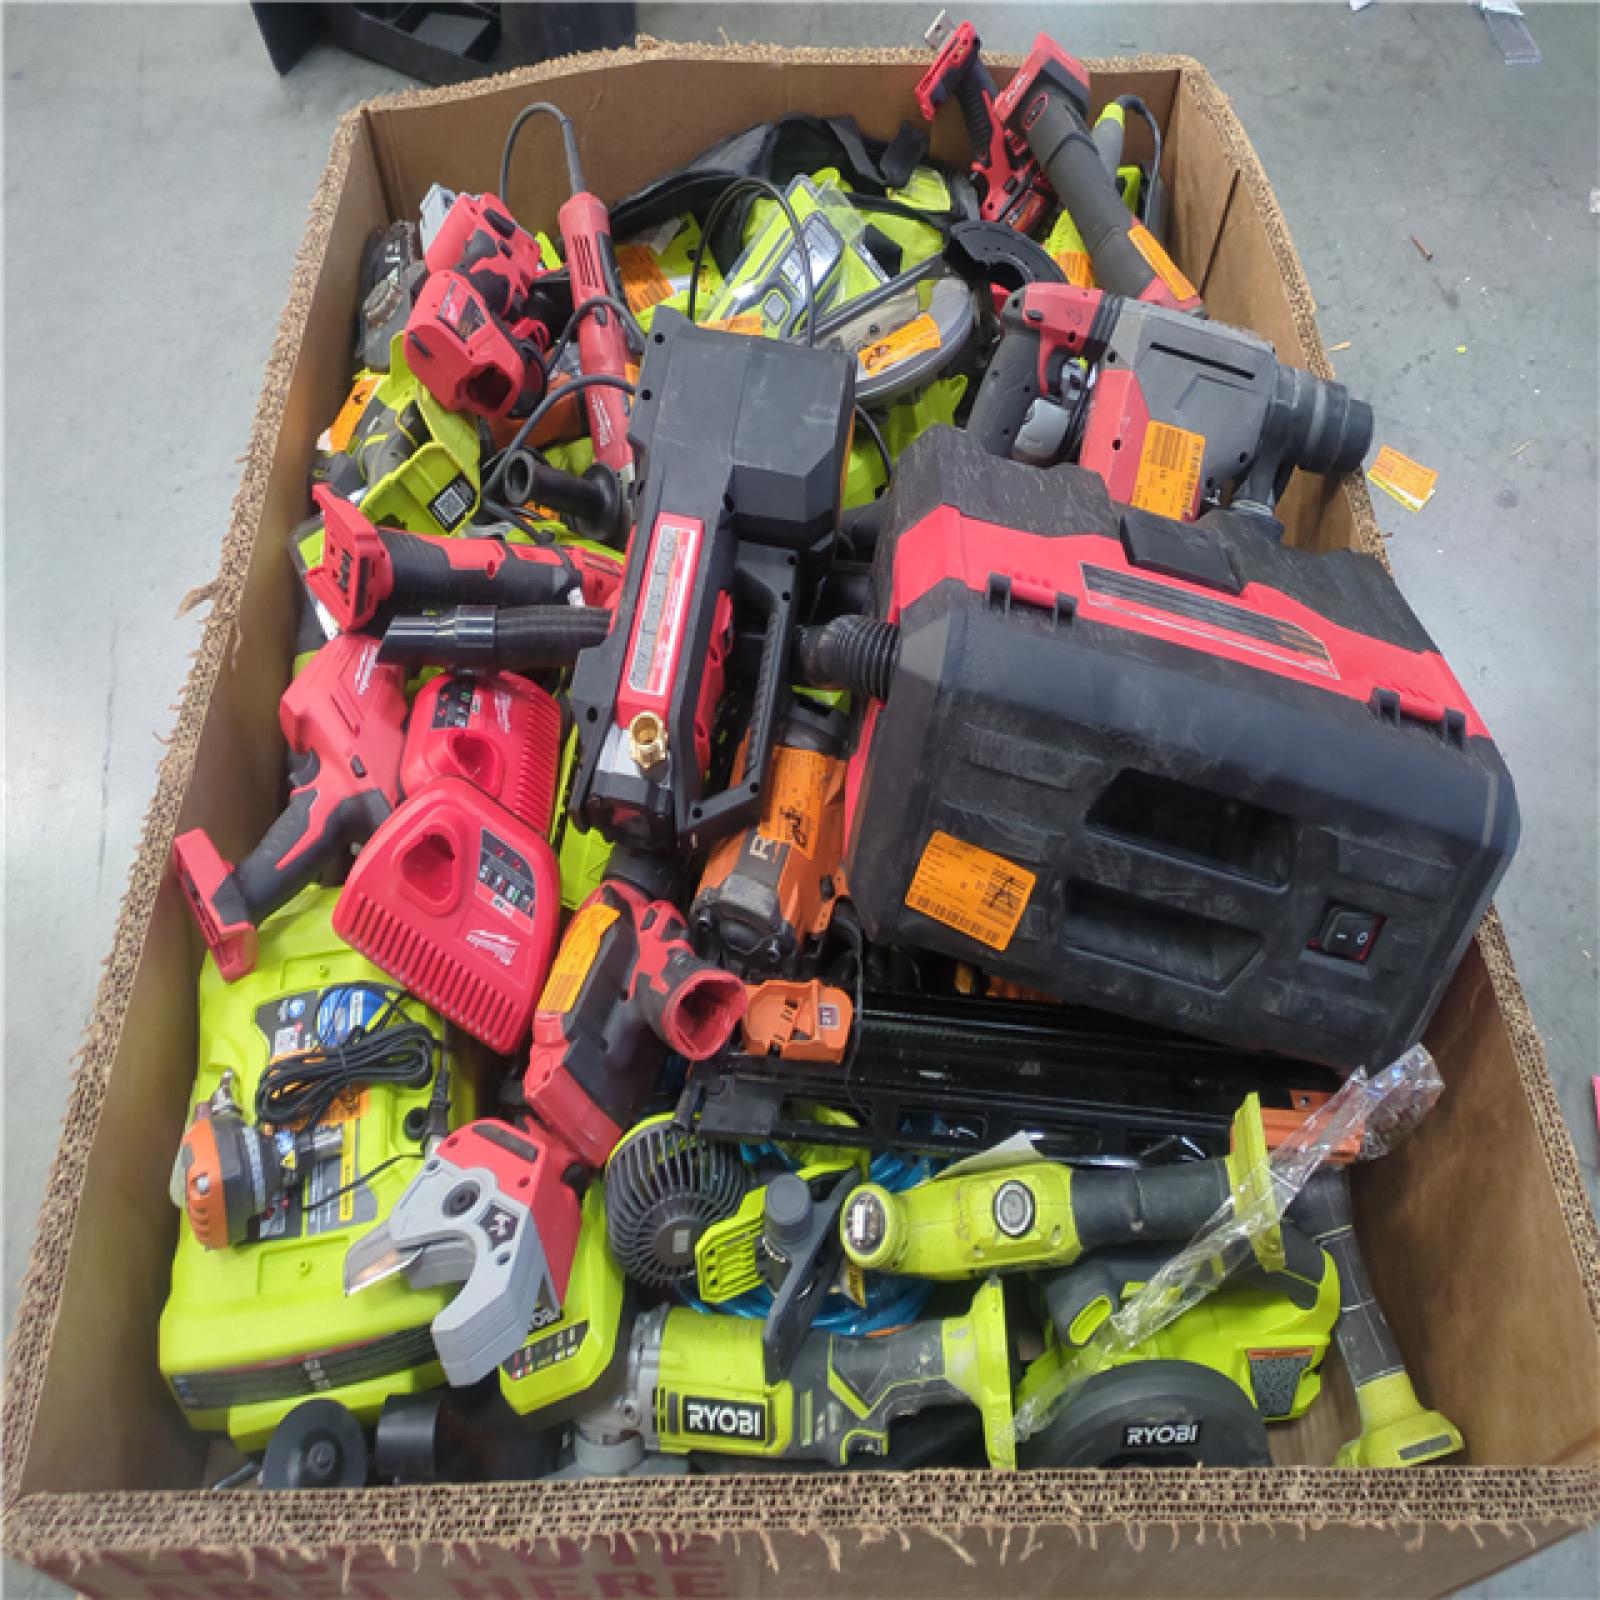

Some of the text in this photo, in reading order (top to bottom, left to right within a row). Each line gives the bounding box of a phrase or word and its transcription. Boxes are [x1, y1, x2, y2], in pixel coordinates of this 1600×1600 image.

[687, 1403, 761, 1436] RYOBI
[1127, 1424, 1198, 1446] RYOBI
[450, 1570, 728, 1600] HERE
